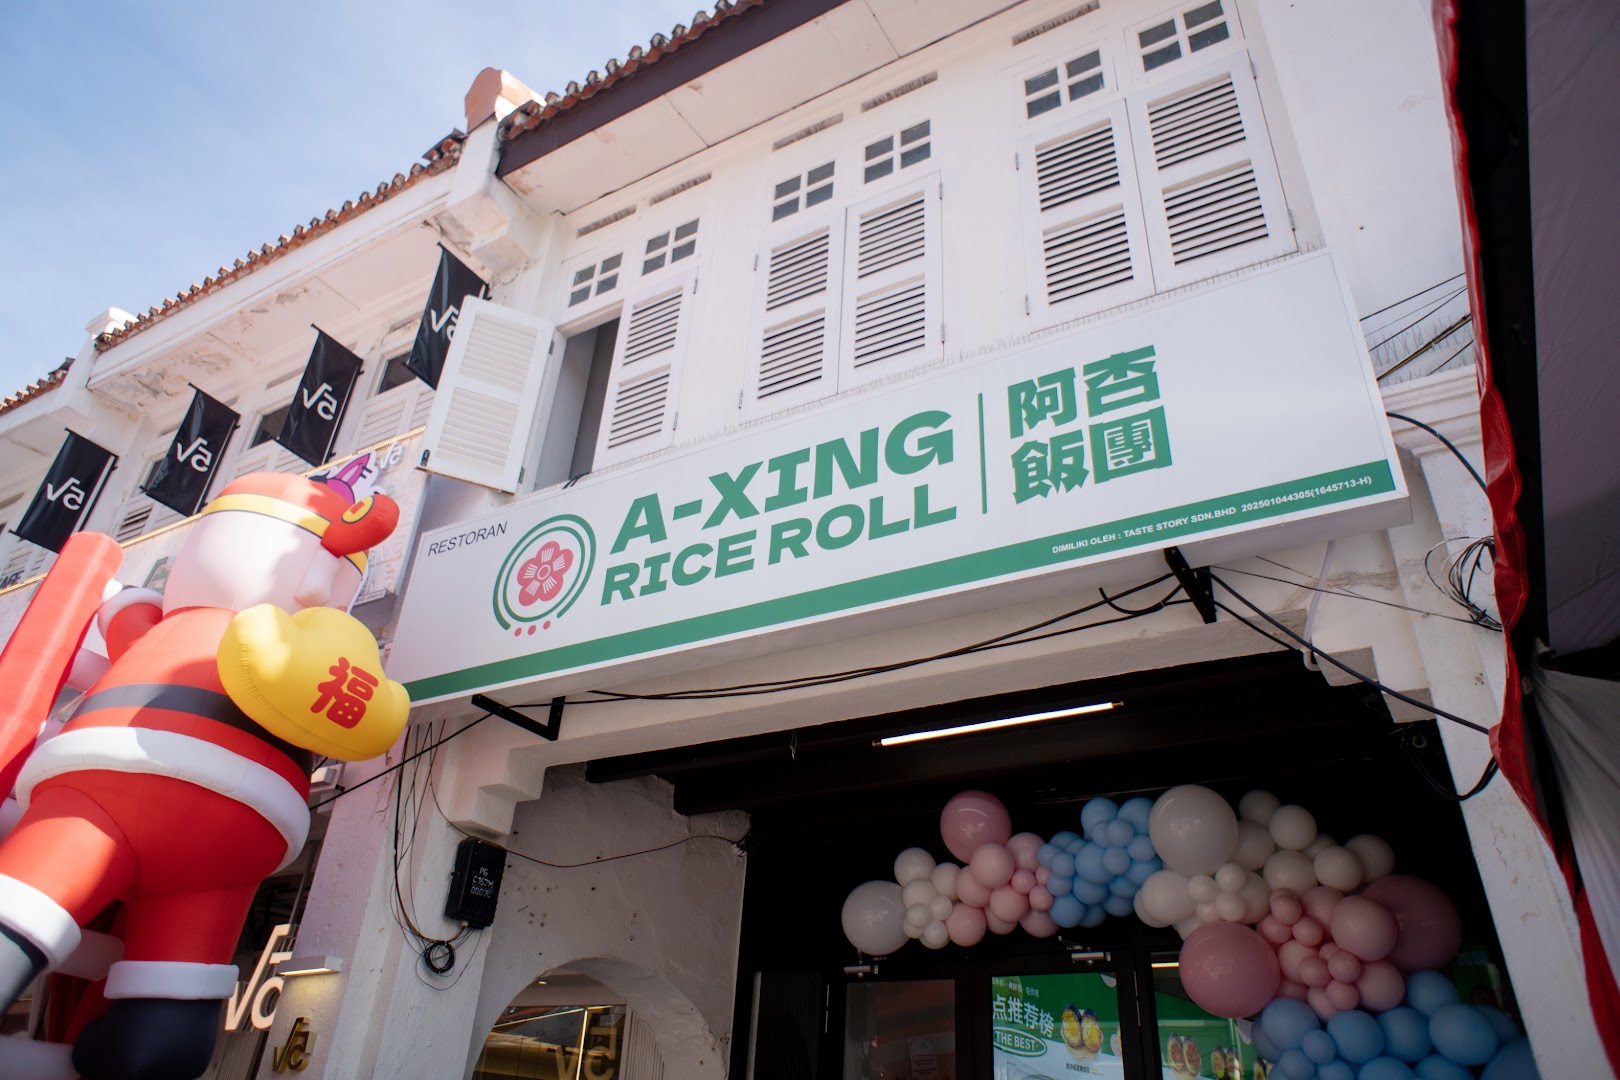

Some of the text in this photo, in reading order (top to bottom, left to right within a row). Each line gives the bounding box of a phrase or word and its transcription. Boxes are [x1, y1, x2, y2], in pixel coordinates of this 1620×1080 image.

[1007, 344, 1161, 439] 阿杏
[610, 410, 955, 554] A-XING
[1010, 405, 1173, 505] 飯團
[427, 521, 508, 557] RESTORAN
[599, 483, 958, 607] RICE ROLL
[1052, 539, 1089, 554] DIMILIKI
[1090, 533, 1116, 546] OLEH
[1123, 524, 1154, 538] TASTE
[1155, 516, 1189, 531] STORY
[1190, 506, 1237, 523] SDN.BHD
[310, 656, 379, 729] 福
[992, 993, 1055, 1038] 点推荐榜
[995, 1031, 1036, 1052] THE BEST
